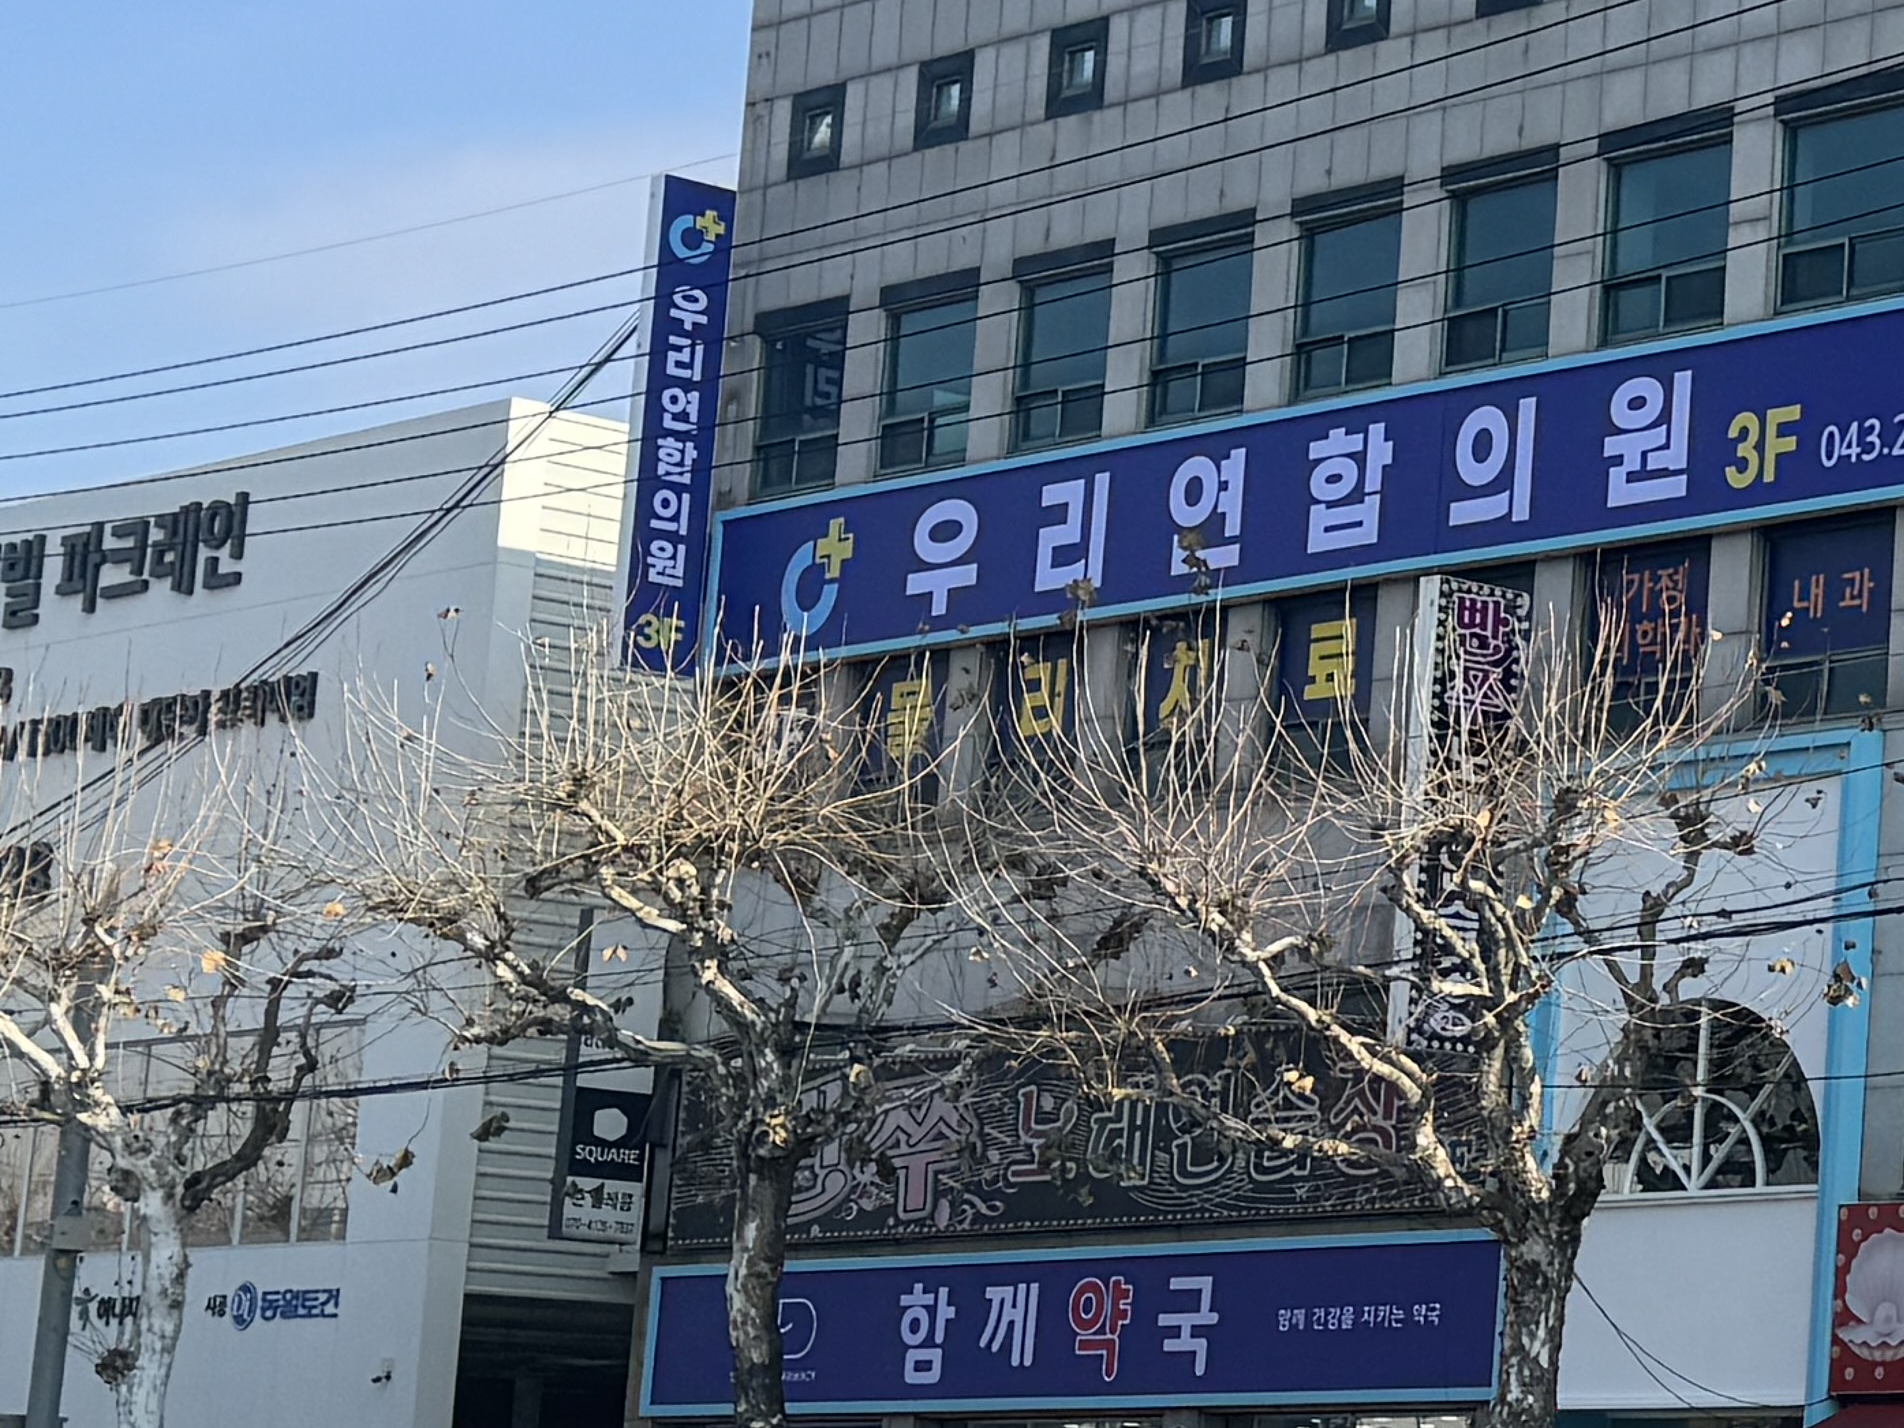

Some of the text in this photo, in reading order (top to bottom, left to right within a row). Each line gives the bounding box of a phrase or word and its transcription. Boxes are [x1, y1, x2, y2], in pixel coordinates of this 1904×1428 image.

[646, 284, 710, 590] 우리연합의원
[905, 369, 1693, 617] 우리연합의원
[1724, 403, 1802, 490] 3F
[55, 491, 250, 615] 파크레인
[1792, 566, 1876, 619] 내과
[574, 1144, 640, 1165] SQUARE
[898, 1273, 1441, 1385] 함께약국 함께 건강을 지키는 약국
